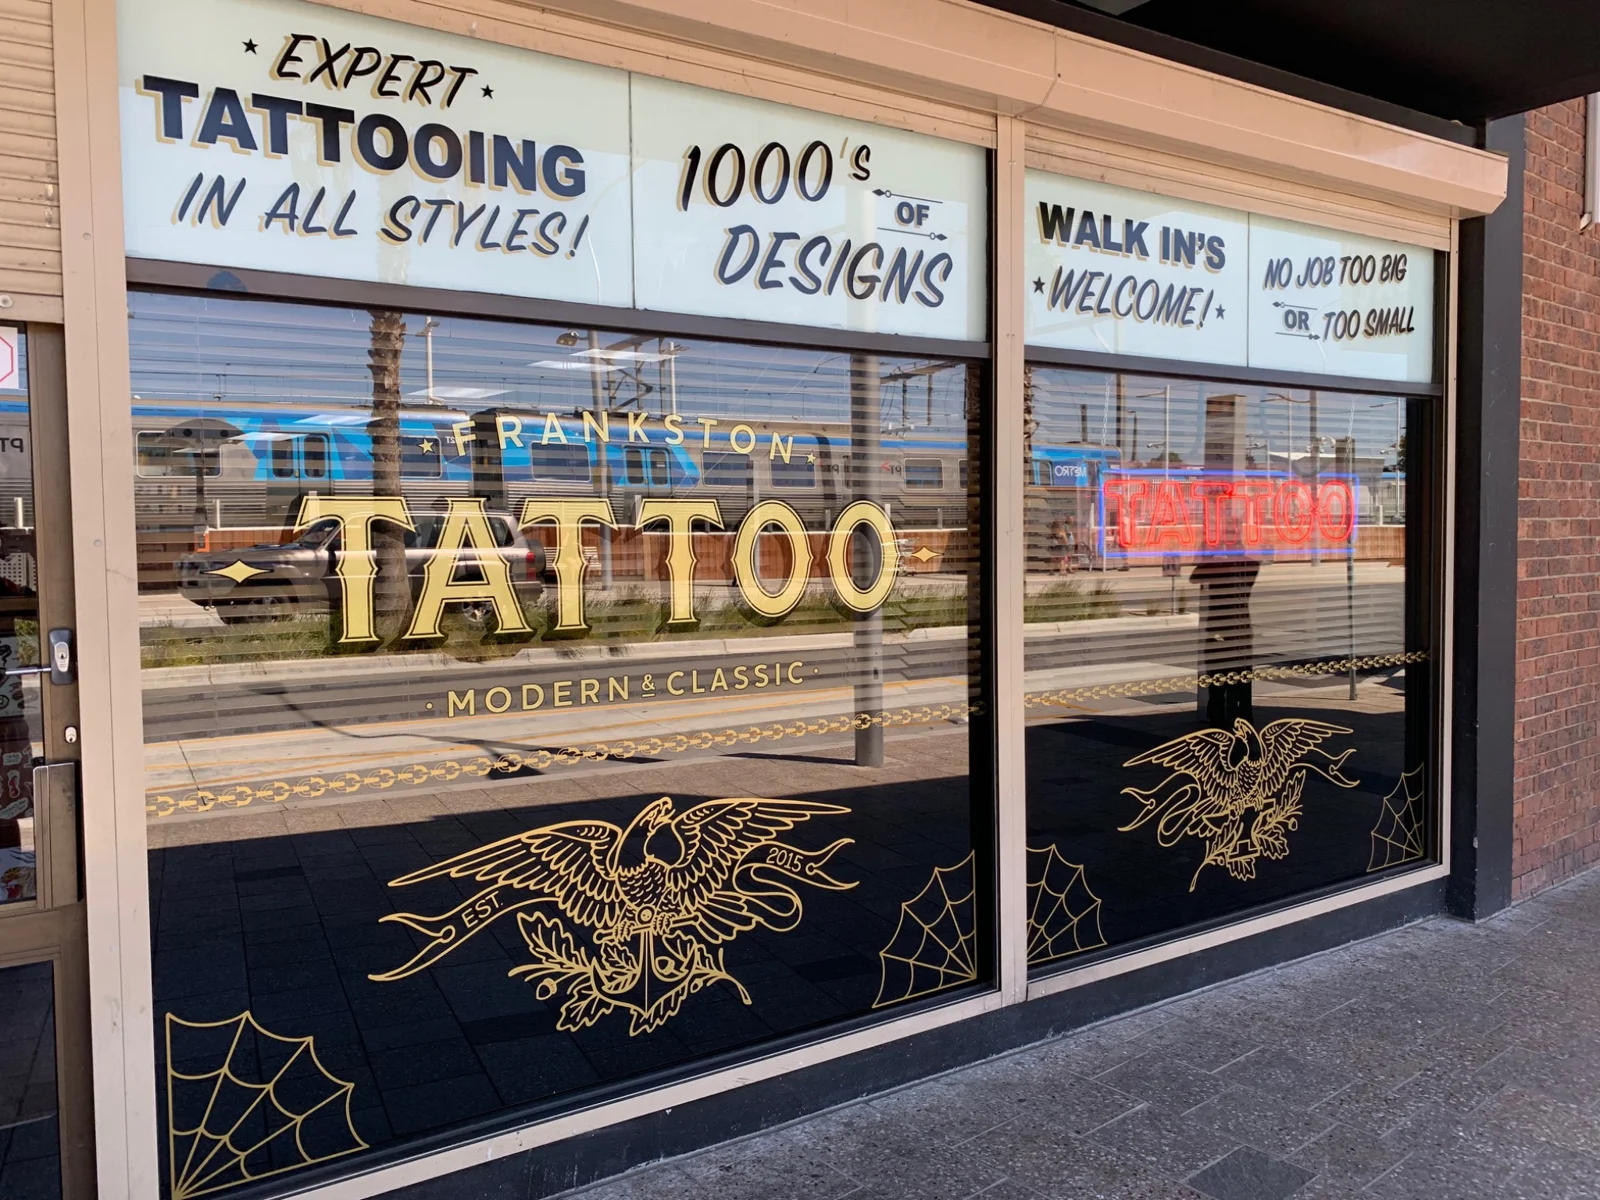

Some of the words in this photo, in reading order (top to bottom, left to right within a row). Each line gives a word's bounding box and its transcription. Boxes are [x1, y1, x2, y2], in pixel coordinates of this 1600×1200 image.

[270, 33, 478, 108] EXPERT
[136, 74, 587, 201] TATTOOING
[172, 172, 246, 229] IN
[259, 182, 357, 239] ALL
[376, 195, 590, 261] STYLES!
[895, 201, 930, 228] OF
[1036, 201, 1150, 261] WALK
[1159, 225, 1227, 273] IN'S
[714, 224, 953, 308] DESIGNS
[1047, 265, 1214, 330] WELCOME!
[1263, 257, 1292, 292] NO
[1296, 256, 1335, 290] JOB
[1337, 254, 1376, 287] TOO
[1379, 253, 1408, 284] BIG
[1283, 309, 1311, 333] OR
[1321, 309, 1368, 342] TOO
[1363, 306, 1415, 339] SMALL
[451, 410, 795, 464] FRANKSTON
[1102, 479, 1356, 548] TATTOO
[293, 495, 900, 646] TATTOO
[446, 673, 630, 718] MODERN
[641, 672, 656, 698] &
[665, 660, 806, 697] CLASSIC
[766, 846, 804, 873] 2015
[462, 889, 504, 929] EST.
